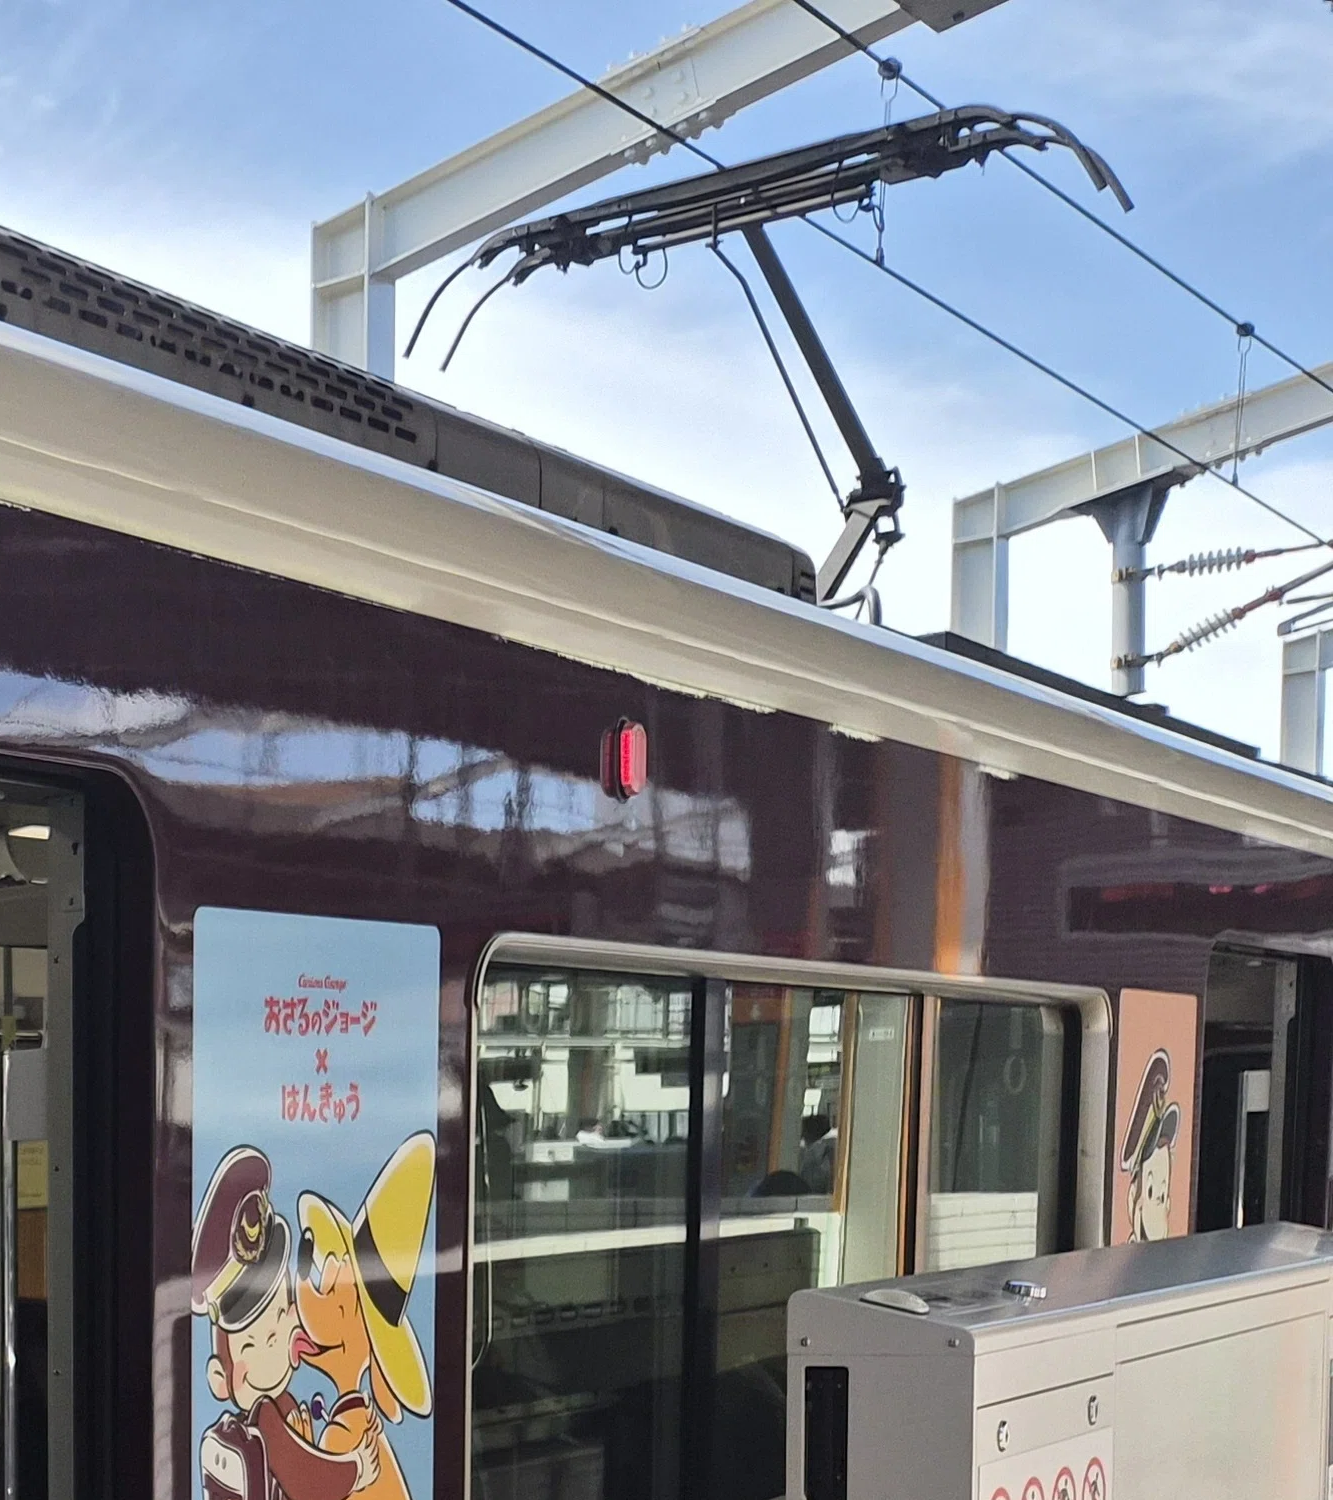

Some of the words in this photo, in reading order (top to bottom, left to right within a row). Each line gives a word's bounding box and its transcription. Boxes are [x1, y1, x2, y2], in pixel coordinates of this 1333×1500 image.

[263, 995, 378, 1037] おさるのジョージ
[280, 1081, 361, 1124] はんきゅう
